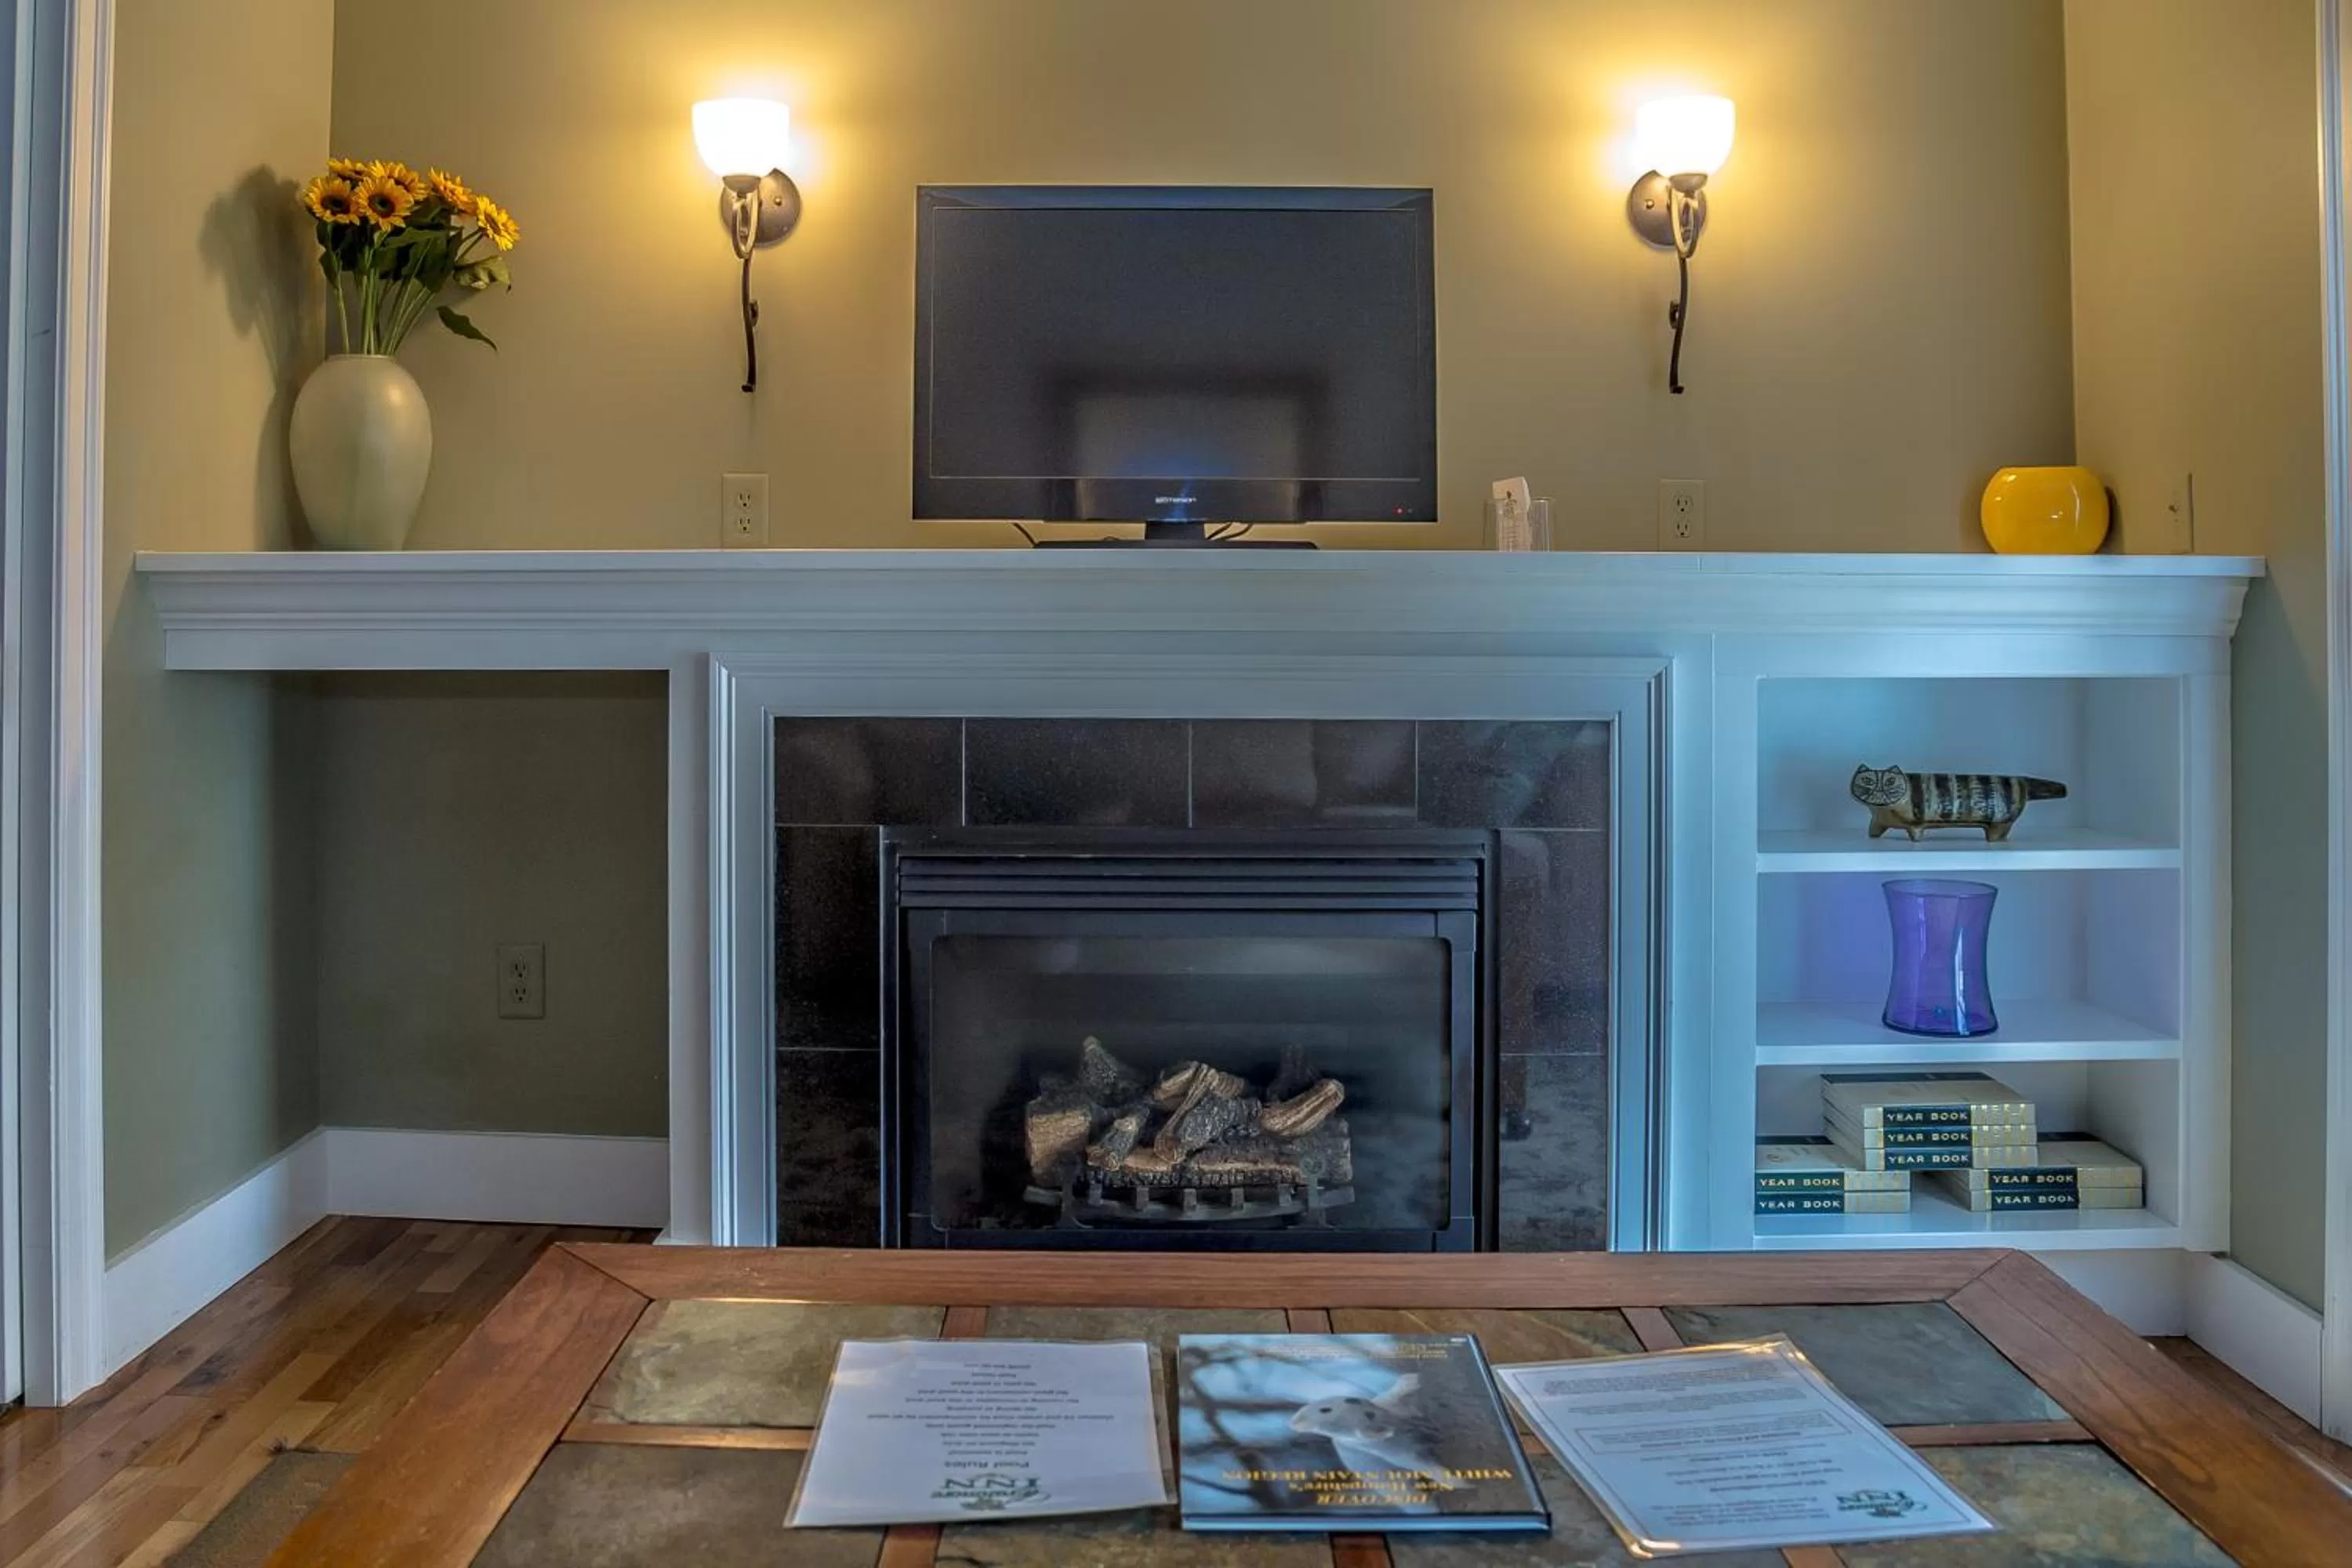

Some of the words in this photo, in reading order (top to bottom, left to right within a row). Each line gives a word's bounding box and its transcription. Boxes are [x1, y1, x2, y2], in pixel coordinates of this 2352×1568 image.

[941, 1477, 1041, 1489] INN
[1414, 1482, 1455, 1491] New
[1316, 1494, 1428, 1505] DISCOVER
